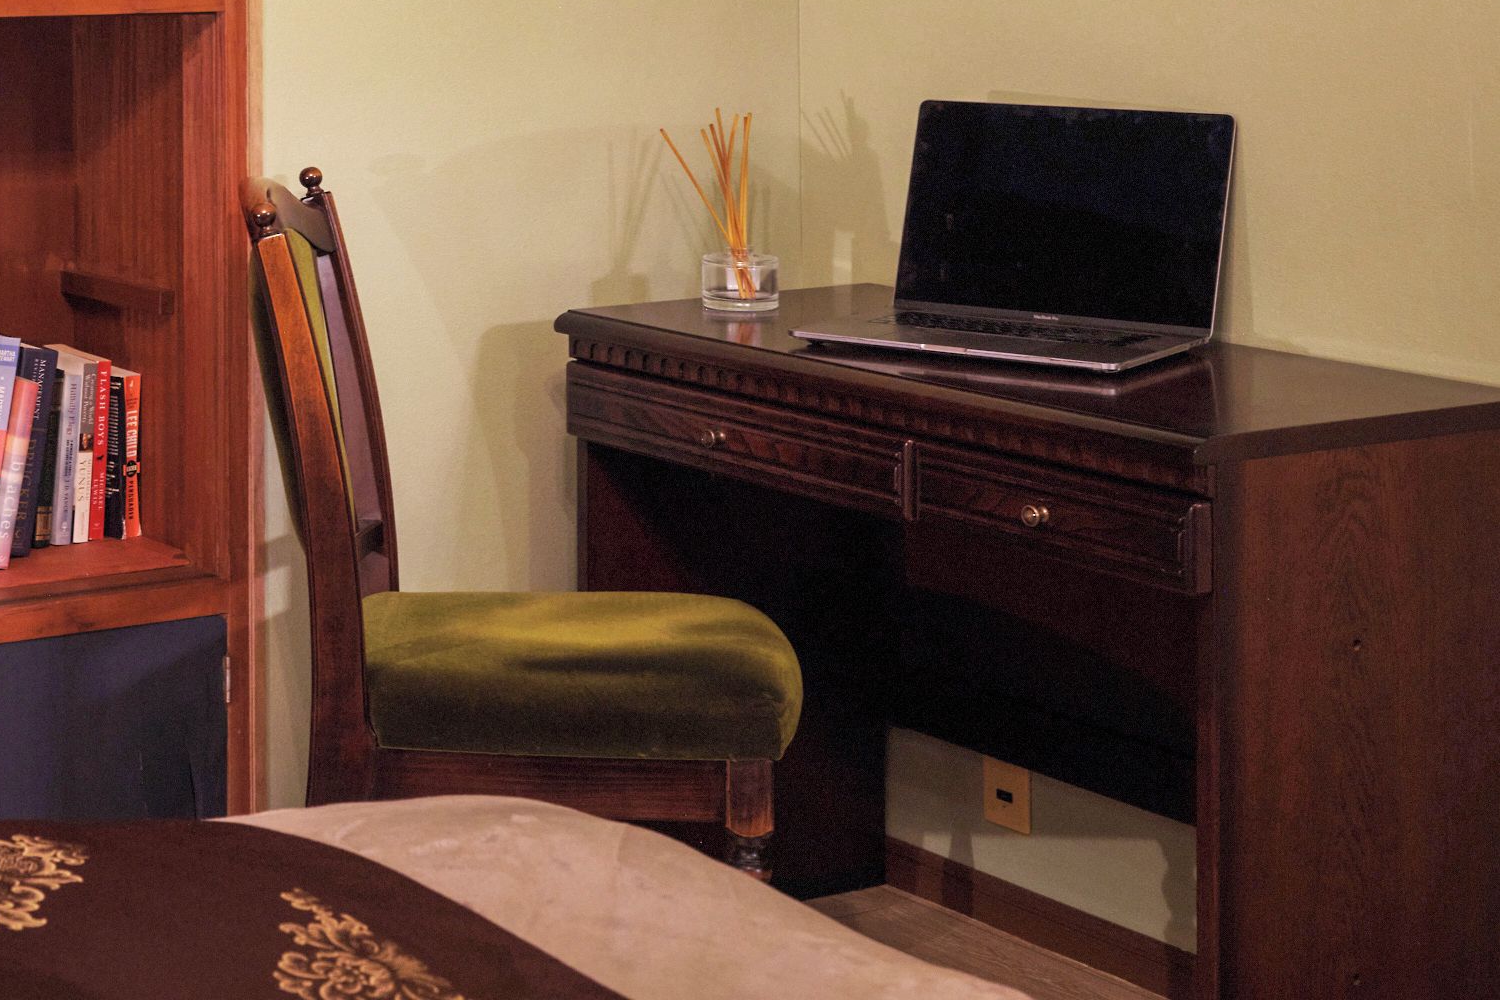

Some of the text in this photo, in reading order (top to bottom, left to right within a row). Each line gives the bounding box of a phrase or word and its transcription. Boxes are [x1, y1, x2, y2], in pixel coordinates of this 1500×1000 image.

[97, 371, 108, 446] FLASH BOYS
[126, 410, 138, 428] LEE
[126, 430, 138, 458] CHILD
[78, 460, 86, 502] YUNUS
